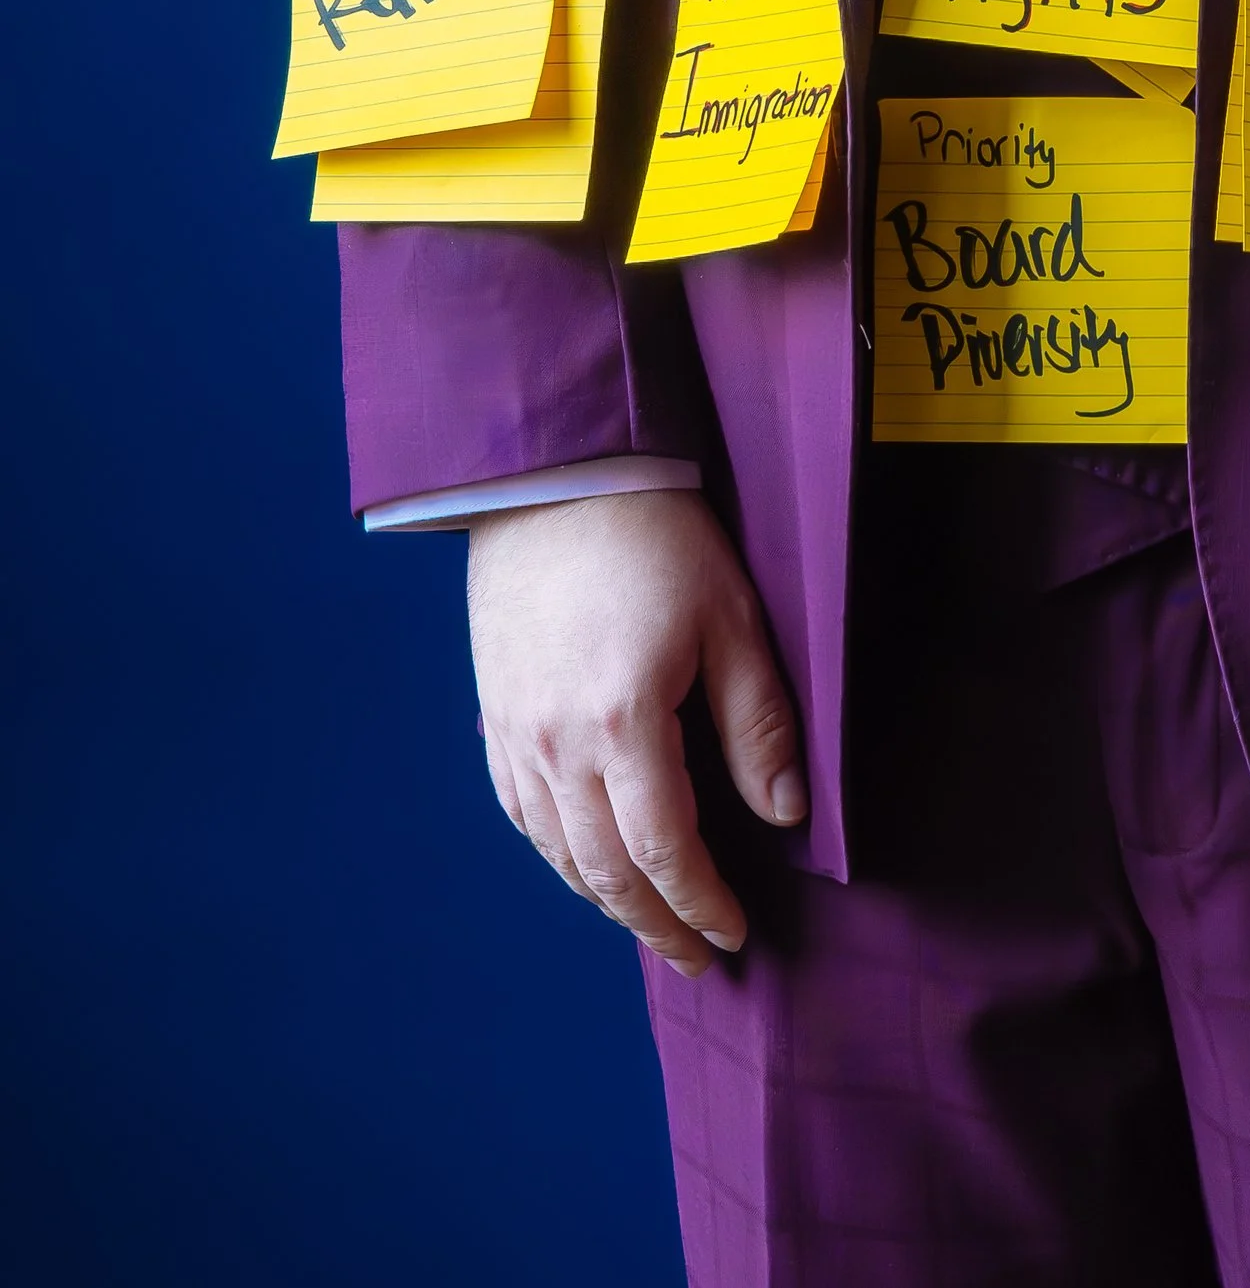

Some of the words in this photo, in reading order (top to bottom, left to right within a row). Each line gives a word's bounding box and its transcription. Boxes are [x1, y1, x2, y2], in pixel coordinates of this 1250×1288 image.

[660, 42, 833, 165] Immigration
[910, 111, 1055, 189] Priority
[883, 193, 1104, 292] Board
[902, 302, 1134, 418] Diversity
